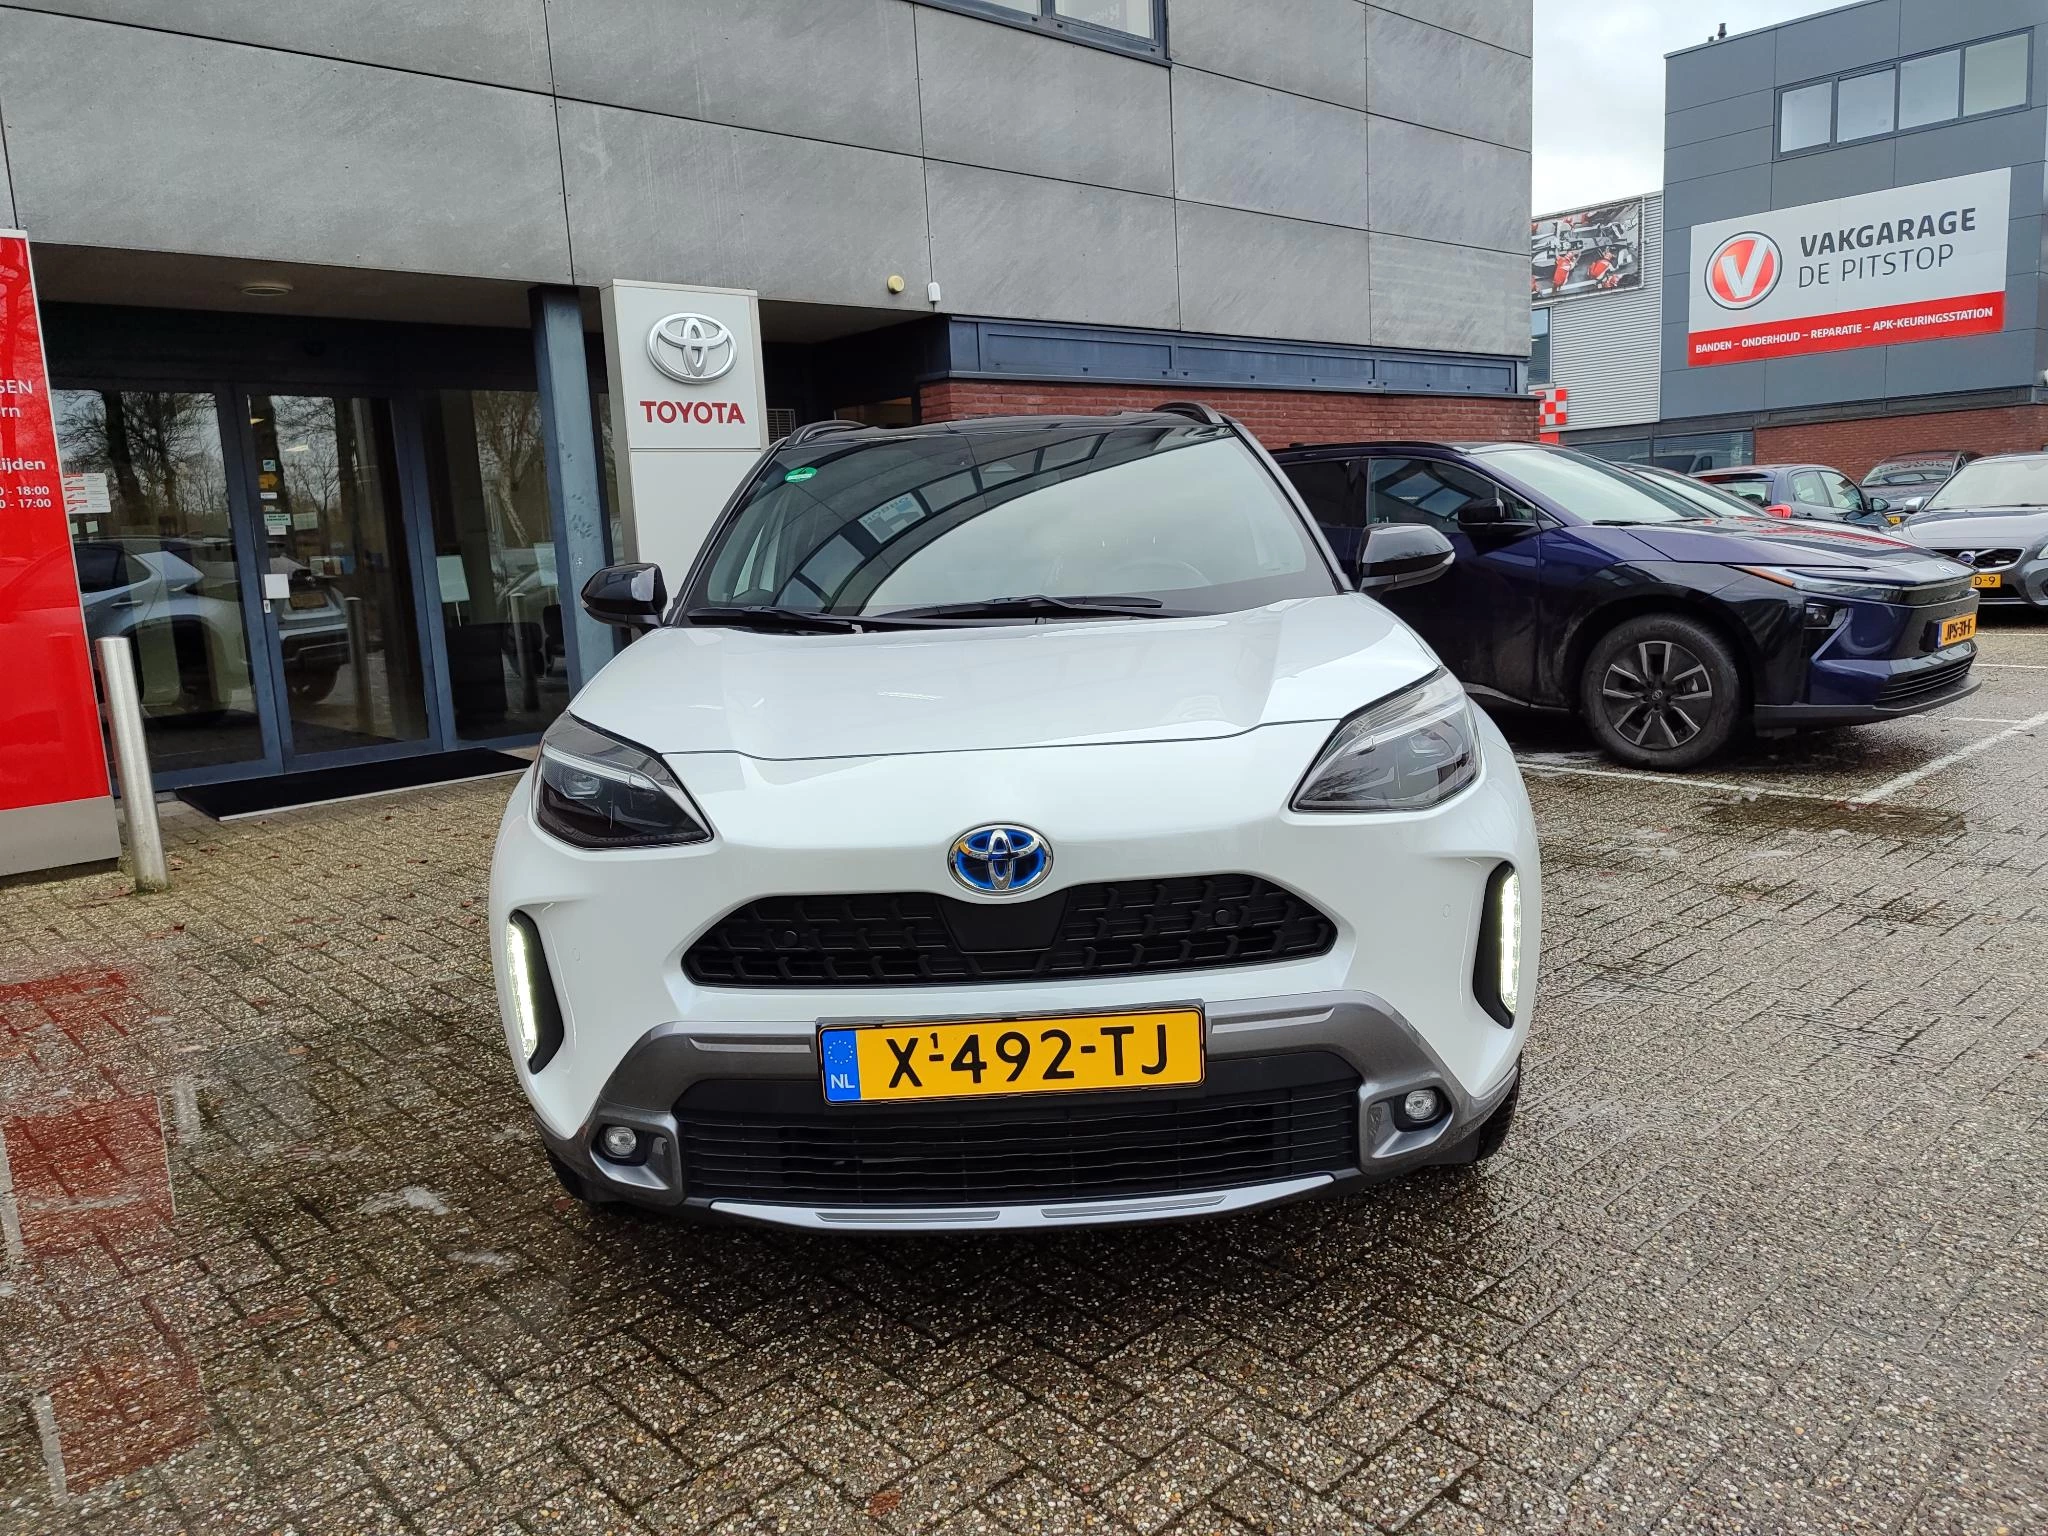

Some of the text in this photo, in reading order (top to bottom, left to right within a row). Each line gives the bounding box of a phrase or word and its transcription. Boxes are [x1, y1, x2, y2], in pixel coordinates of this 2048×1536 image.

[1800, 207, 1976, 257] VAKGARAGE
[1799, 243, 1954, 288] DE PITSTOP
[1695, 340, 1732, 354] BANDEN
[1741, 331, 1800, 347] ONDERHOUD
[1810, 323, 1862, 339] REPARATIE
[1872, 306, 1993, 331] APK-KEURINGSSTATION
[639, 400, 746, 425] TOYOTA
[16, 485, 49, 496] 18:00
[17, 498, 52, 509] 17:00
[1974, 576, 1996, 586] D-9
[830, 1074, 856, 1090] NL
